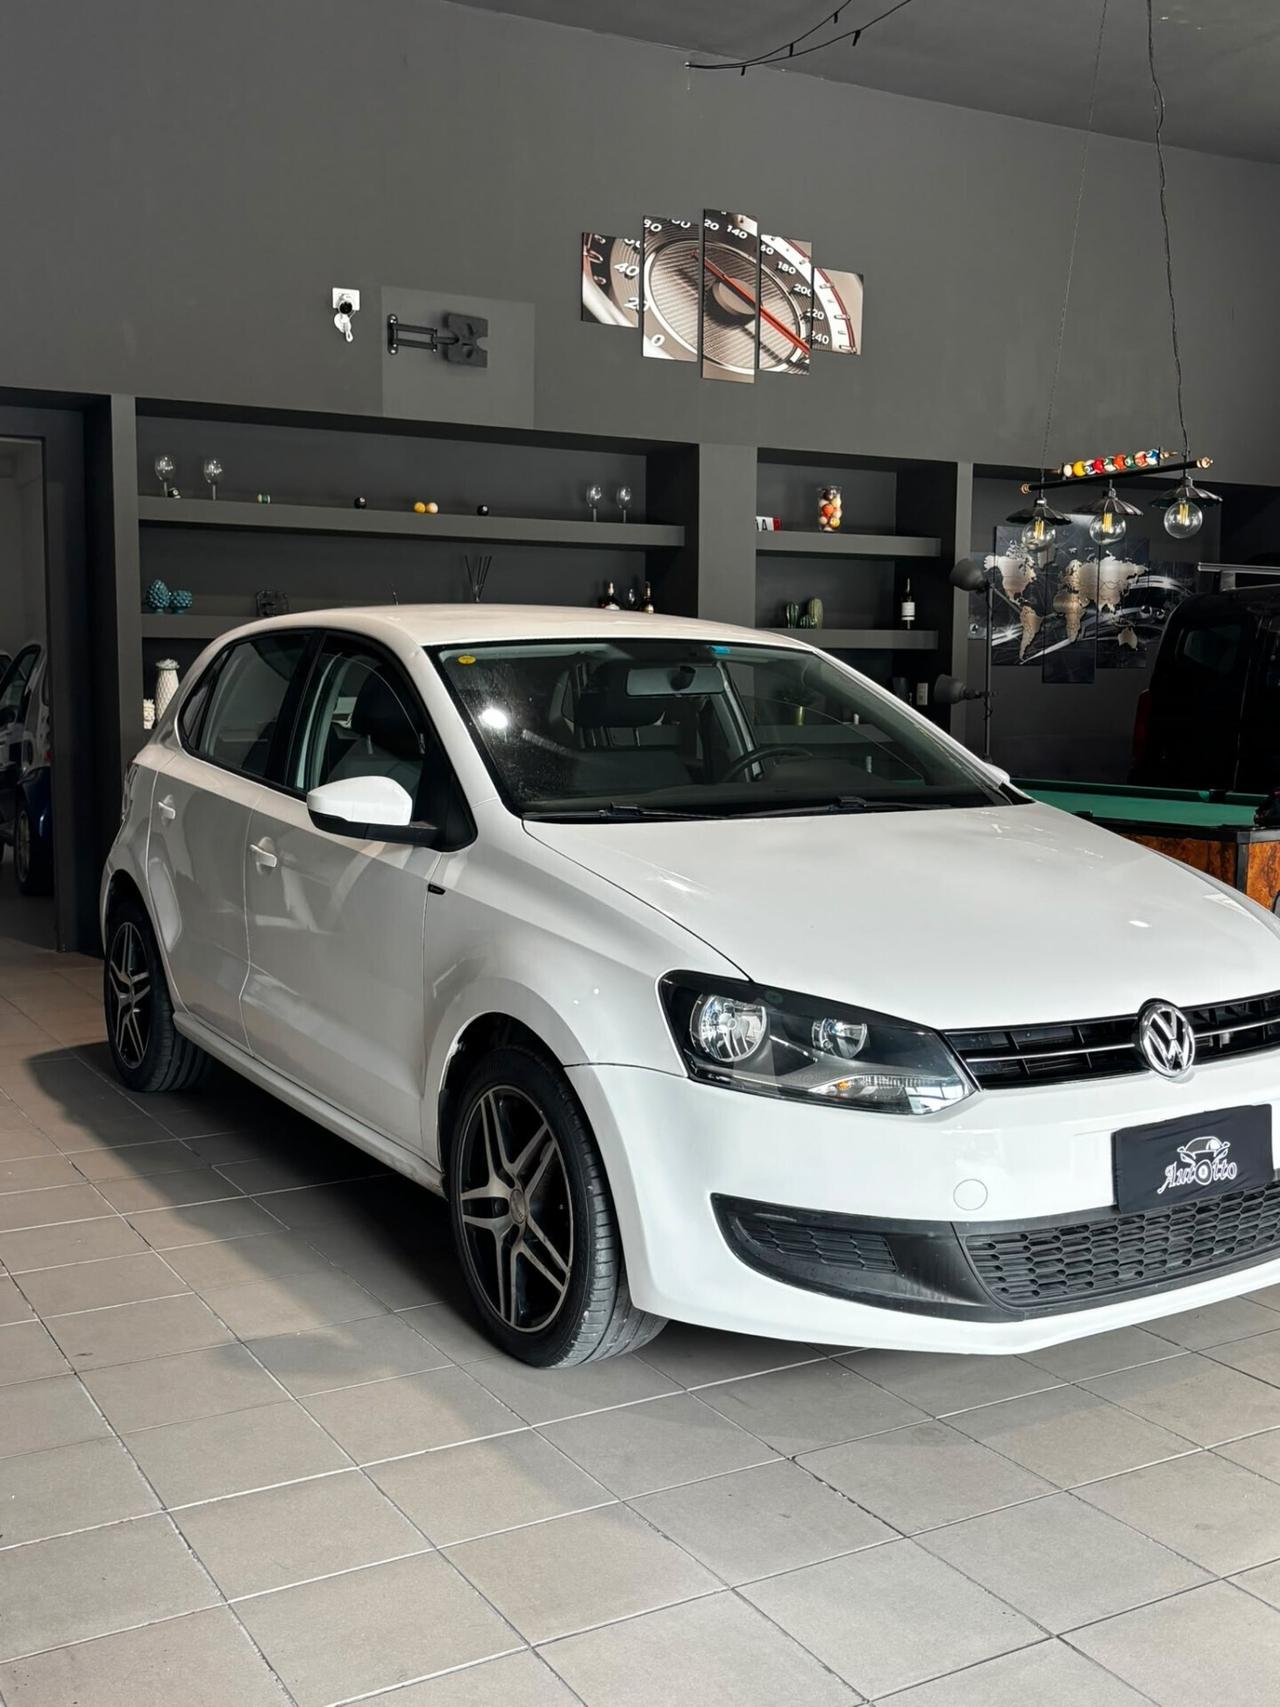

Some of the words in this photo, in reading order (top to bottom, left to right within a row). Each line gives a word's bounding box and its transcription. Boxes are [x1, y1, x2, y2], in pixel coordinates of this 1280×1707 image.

[727, 225, 748, 240] 140
[613, 262, 640, 277] 40
[777, 261, 796, 275] 180
[793, 283, 812, 298] 200
[652, 333, 665, 347] 0
